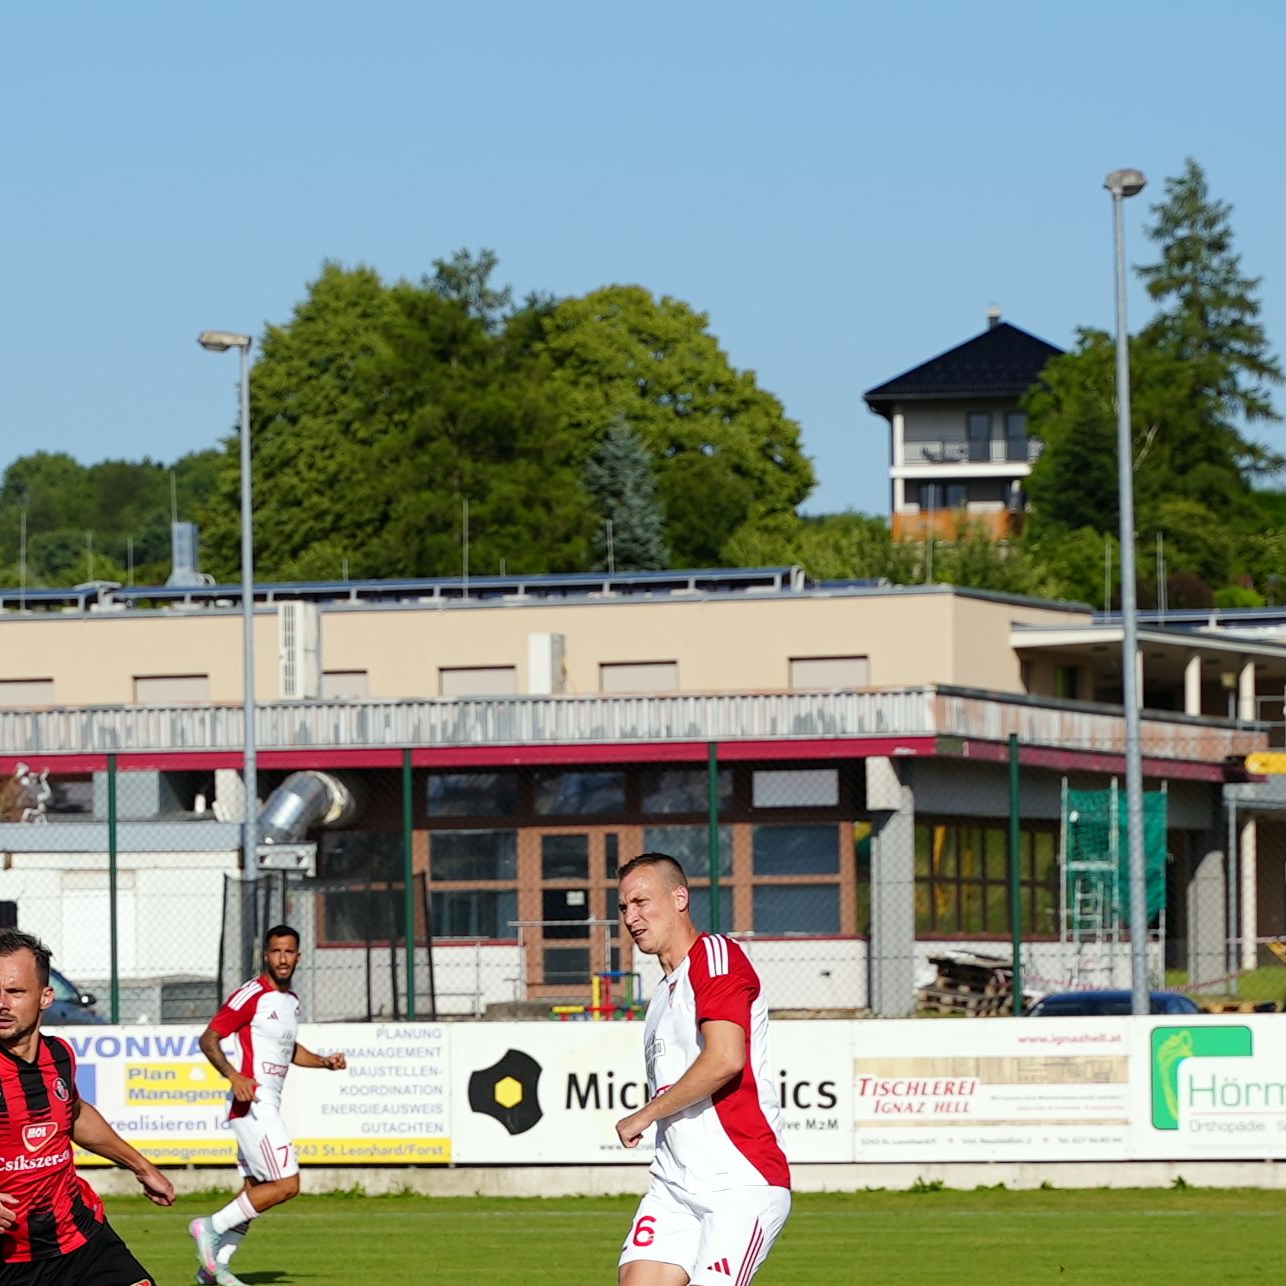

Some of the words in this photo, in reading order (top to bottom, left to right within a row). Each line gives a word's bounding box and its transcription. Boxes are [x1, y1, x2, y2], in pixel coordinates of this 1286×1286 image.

[377, 1028, 442, 1039] PLANUNG
[128, 1068, 176, 1080] Plan
[349, 1066, 443, 1077] BAUSTELLEN-
[340, 1085, 442, 1096] KOORDINATION
[859, 1078, 975, 1096] TISCHLEREI
[128, 1088, 228, 1102] Managem
[321, 1104, 443, 1115] ENERGIEAUSWEIS
[874, 1100, 926, 1113] IGNAZ
[934, 1102, 970, 1113] HELL
[361, 1122, 443, 1134] GUTACHTEN
[295, 1144, 317, 1156] 243
[633, 1214, 657, 1248] 6
